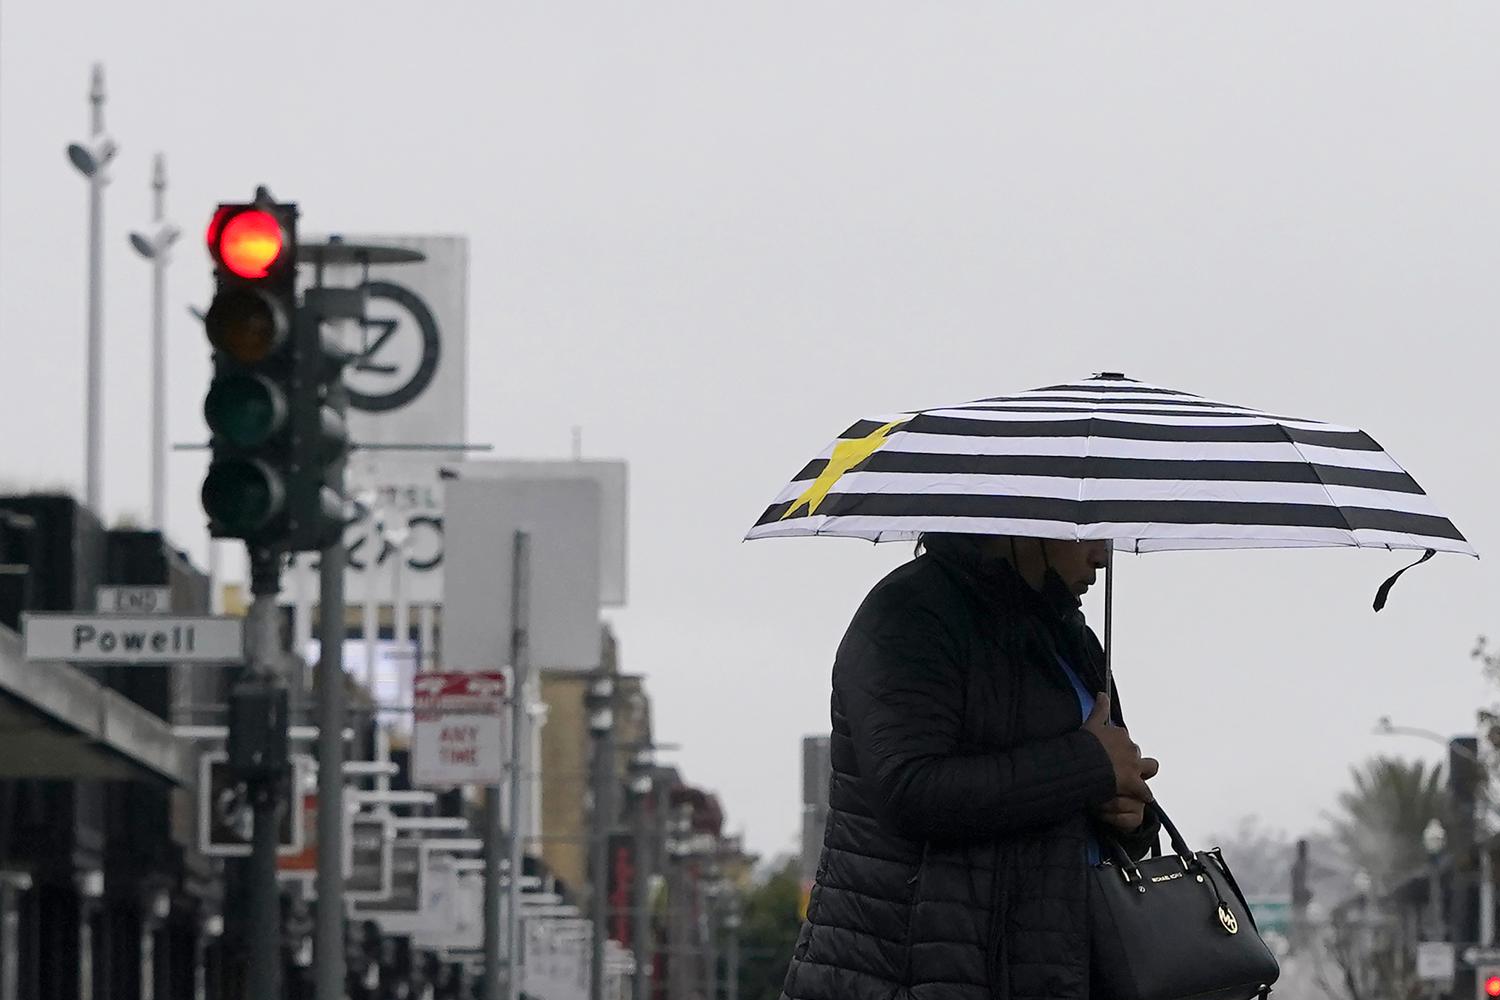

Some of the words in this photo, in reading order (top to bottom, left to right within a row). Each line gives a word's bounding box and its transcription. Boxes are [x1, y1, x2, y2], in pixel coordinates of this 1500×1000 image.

[73, 624, 196, 652] Powell
[439, 726, 480, 742] ANY
[439, 749, 480, 766] TIME
